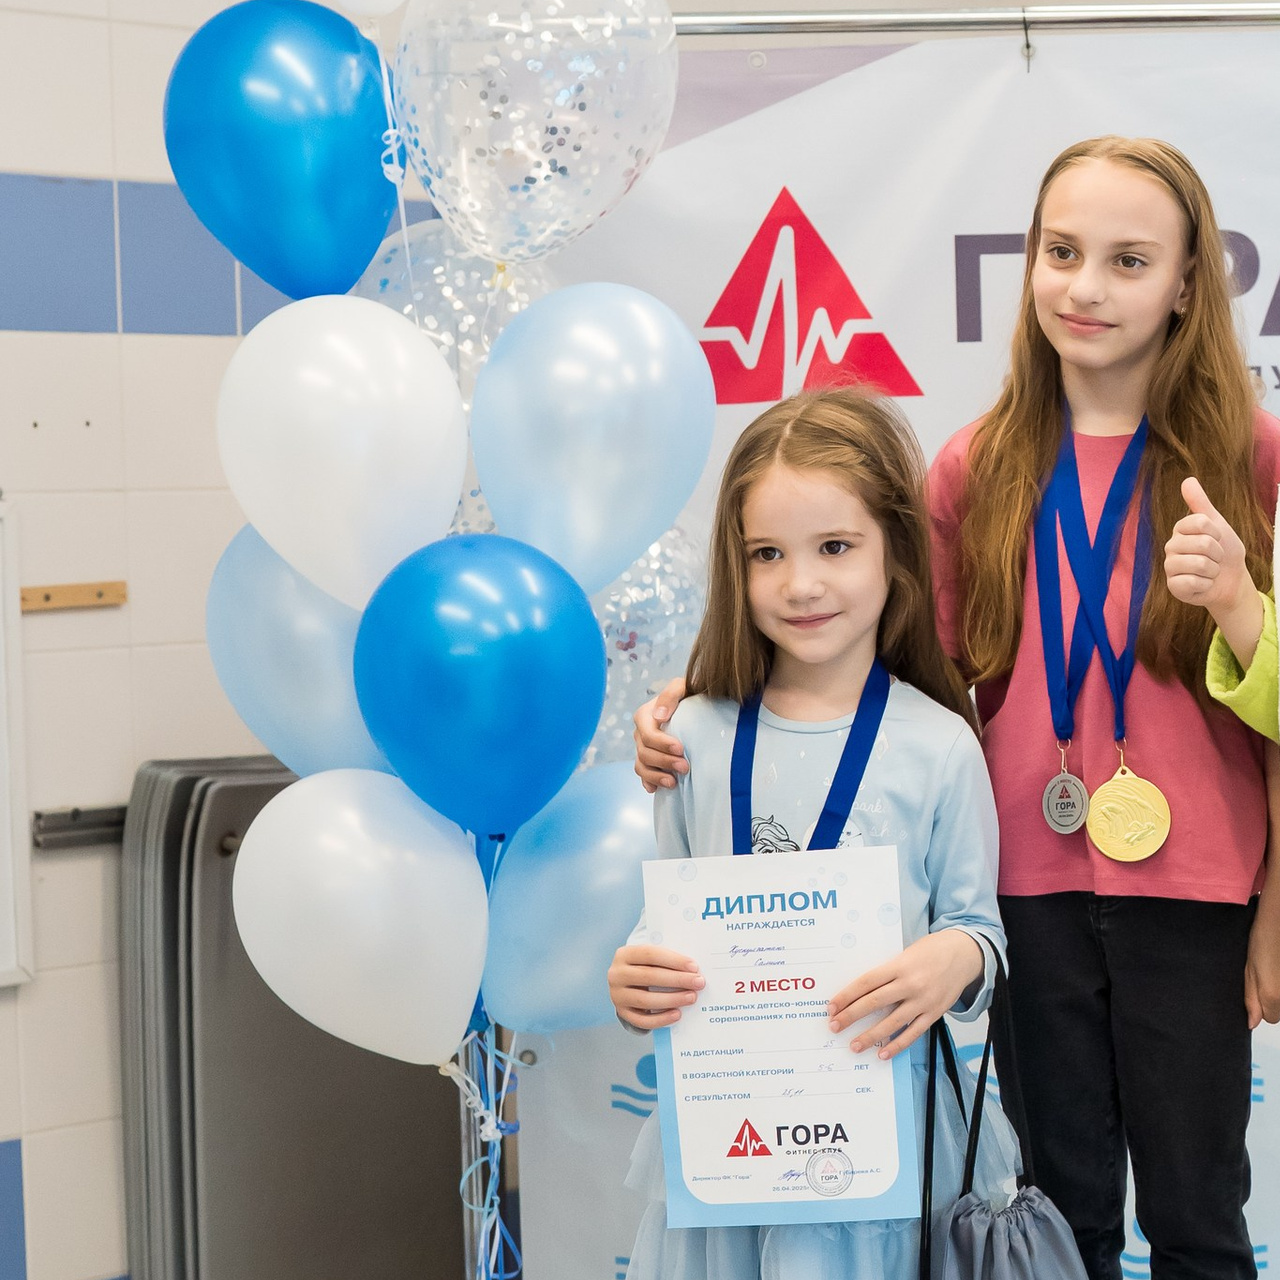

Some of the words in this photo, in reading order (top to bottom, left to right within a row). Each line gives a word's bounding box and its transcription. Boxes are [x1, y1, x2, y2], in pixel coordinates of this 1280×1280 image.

[1055, 801, 1077, 811] ГОРА
[701, 889, 838, 920] ДИПЛОМ
[726, 918, 816, 932] НАГРАЖДАЕТСЯ
[734, 981, 746, 994] 2
[750, 977, 816, 993] МЕСТО
[708, 1003, 756, 1013] закрытых
[757, 999, 830, 1010] детско-юноше
[709, 1014, 784, 1024] соревнованиях
[799, 1010, 830, 1019] плава
[693, 1048, 744, 1058] ДИСТАНЦИИ
[689, 1070, 745, 1080] ВОЗРАСТНОЙ
[745, 1068, 795, 1077] КАТЕГОРИИ
[691, 1093, 751, 1102] РЕЗУЛЬТАТОМ
[775, 1123, 850, 1146] ГОРА
[785, 1147, 843, 1156] ФИТНЕС-КЛУБ
